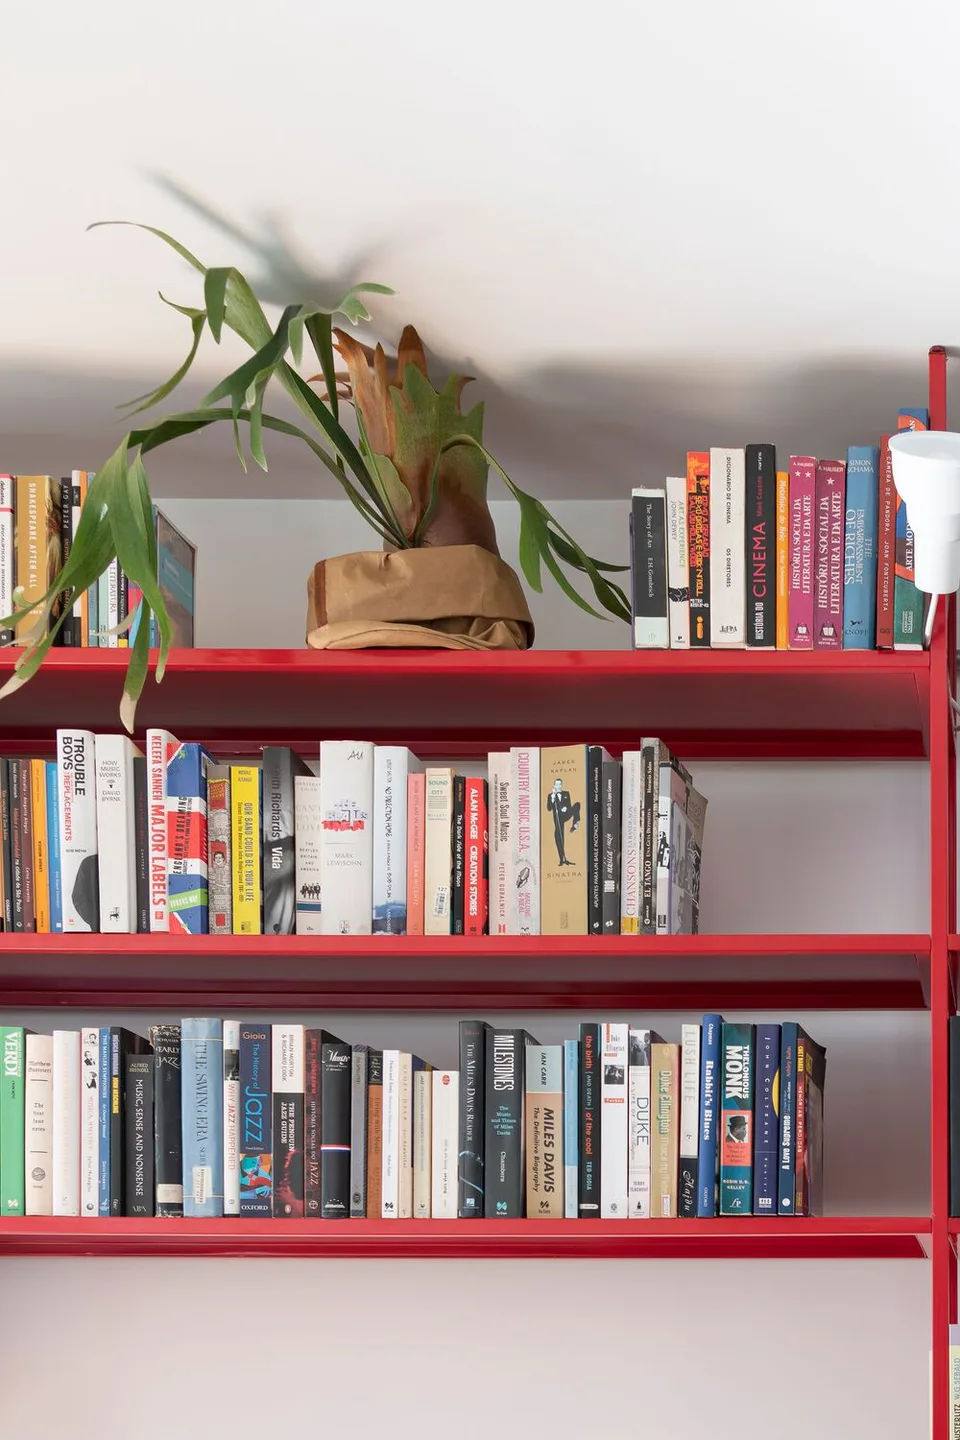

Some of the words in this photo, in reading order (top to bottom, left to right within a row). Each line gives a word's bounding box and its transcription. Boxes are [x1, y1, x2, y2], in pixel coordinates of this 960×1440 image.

[820, 497, 829, 511] DA
[818, 513, 828, 554] SOCIAL
[845, 509, 856, 530] OF
[845, 534, 855, 585] RICHES
[856, 509, 865, 584] EMBARRASSMENT
[816, 557, 828, 608] HISTÓRIA
[62, 737, 73, 770] BOYS
[152, 736, 162, 764] KELEFA
[74, 737, 85, 796] TROUBLE
[152, 767, 162, 802] SANNEH
[470, 788, 478, 808] ALAN
[500, 782, 509, 806] Sweet
[64, 775, 72, 841] REPLACEMENTS
[244, 803, 253, 816] OUR
[271, 792, 283, 838] Richards
[500, 807, 509, 820] Soul
[151, 804, 165, 852] MAJOR
[245, 818, 253, 834] BAND
[470, 810, 478, 839] McGEE
[500, 822, 510, 842] Music
[245, 837, 253, 858] COULD
[271, 847, 283, 869] Vida
[469, 845, 478, 884] CREATION
[644, 860, 652, 887] TANGO
[152, 857, 166, 905] LABELS
[245, 871, 253, 887] YOUR
[626, 850, 636, 916] CHANSONS
[644, 888, 651, 898] EL
[246, 889, 254, 902] LIFE
[469, 885, 478, 916] STORIES
[242, 1032, 266, 1040] Gioia
[466, 1042, 475, 1056] THE
[5, 1032, 18, 1077] VERDI
[156, 1057, 181, 1068] JAZZ
[195, 1042, 208, 1072] THE
[493, 1035, 514, 1091] MILESTONES
[467, 1058, 476, 1086] MILES
[660, 1070, 672, 1094] Duke
[726, 1045, 743, 1099] MONK
[135, 1079, 143, 1106] MUSIC,
[195, 1075, 208, 1113] SWING
[466, 1088, 476, 1113] DAVIS
[135, 1107, 144, 1131] SENSE
[245, 1086, 267, 1143] Jazz
[466, 1114, 475, 1142] READER
[543, 1107, 555, 1148] MILES
[585, 1113, 593, 1122] of
[636, 1097, 649, 1145] DUKE
[659, 1096, 672, 1134] Ellington
[196, 1116, 208, 1142] ERA
[783, 1116, 791, 1144] Supreme
[135, 1153, 144, 1196] NONSENSE
[543, 1152, 555, 1193] DAVIS
